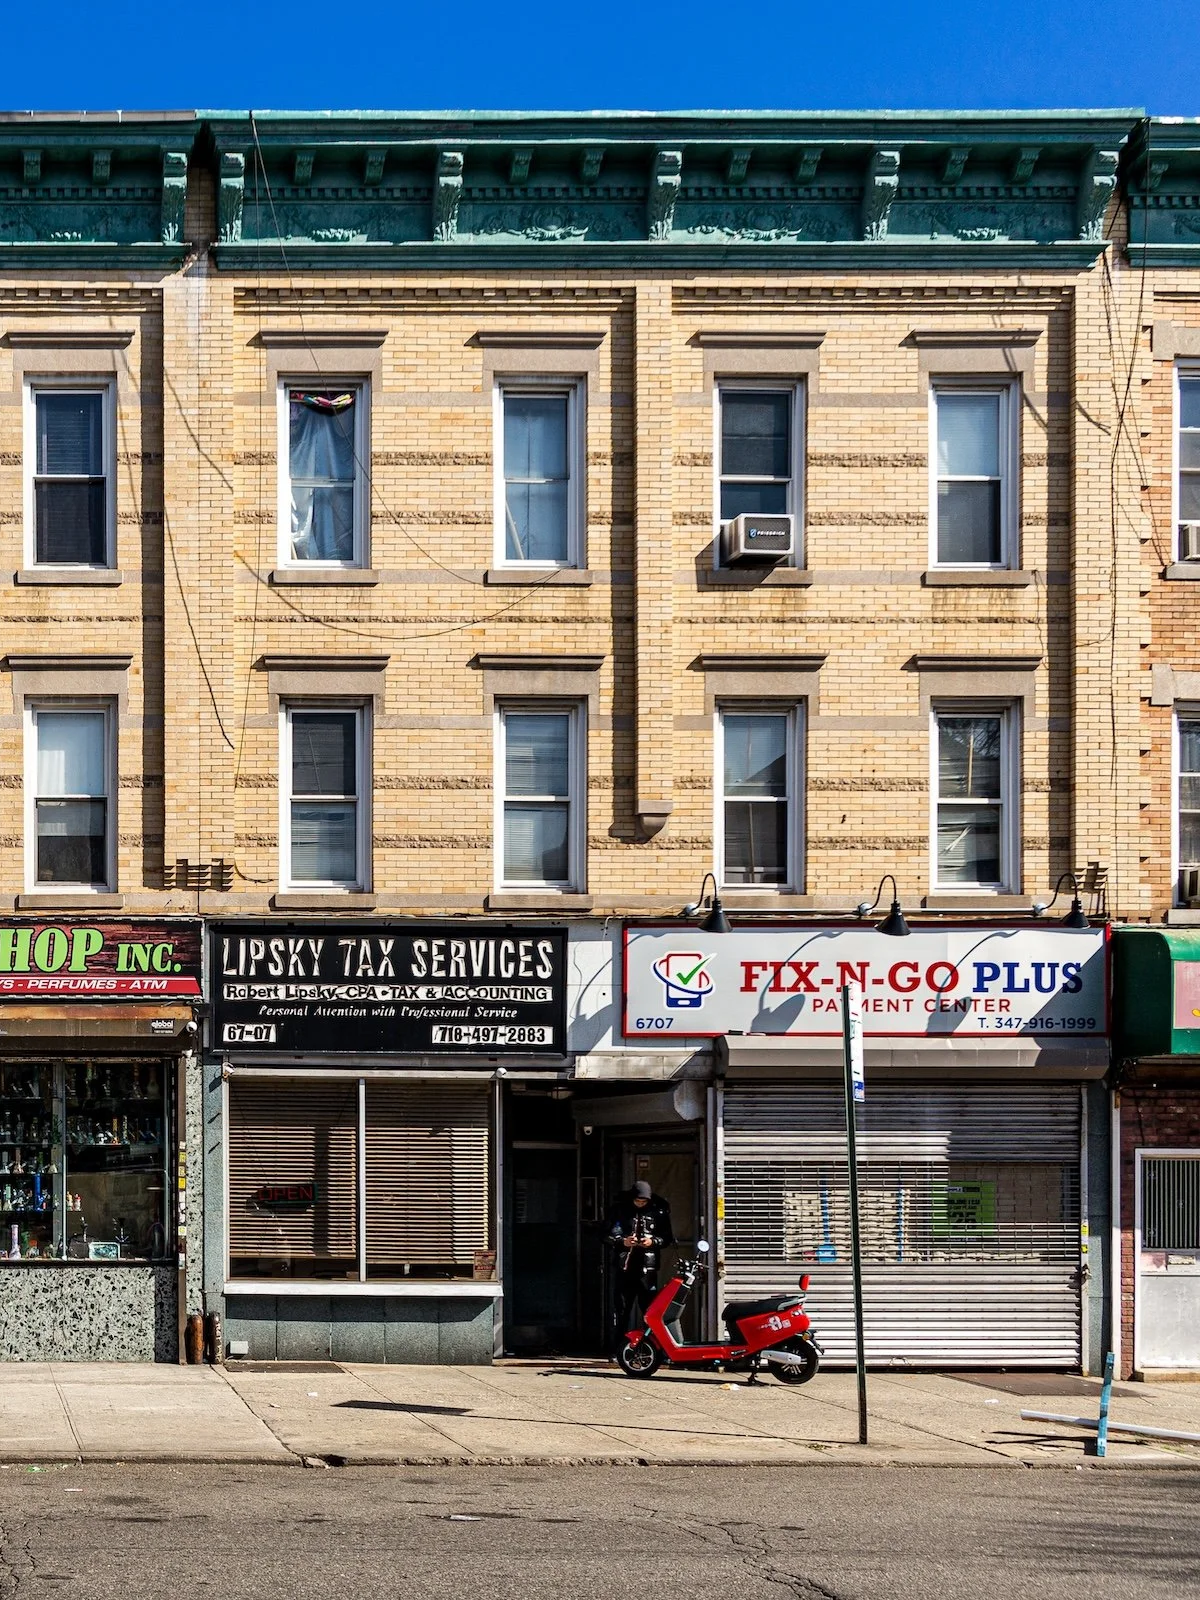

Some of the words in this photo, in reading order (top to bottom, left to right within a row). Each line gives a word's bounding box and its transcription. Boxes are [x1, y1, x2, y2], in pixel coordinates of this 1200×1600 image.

[115, 943, 183, 974] INC.
[222, 937, 325, 977] LIPSKY
[337, 938, 396, 978] TAX
[410, 938, 554, 979] SERVICES
[26, 978, 118, 990] PERFUMES
[128, 978, 168, 990] ATM
[739, 960, 960, 994] FIX-N-GO
[972, 961, 1084, 994] PLUS
[226, 985, 280, 998] Robert
[426, 986, 438, 999] &
[444, 986, 549, 1000] ACCOUNTING
[259, 1004, 309, 1016] Personal
[313, 1005, 367, 1017] Attention
[372, 1006, 396, 1017] with
[401, 1006, 471, 1019] Professional
[474, 1006, 518, 1018] Service
[812, 998, 914, 1012] PAMENT
[923, 998, 1011, 1013] CENTER
[636, 1017, 674, 1029] 6707
[977, 1017, 990, 1029] T.
[994, 1017, 1097, 1029] 347-916-1999
[227, 1025, 272, 1041] 67-07
[437, 1026, 546, 1043] 718-497-2883
[258, 1185, 313, 1201] OPEN
